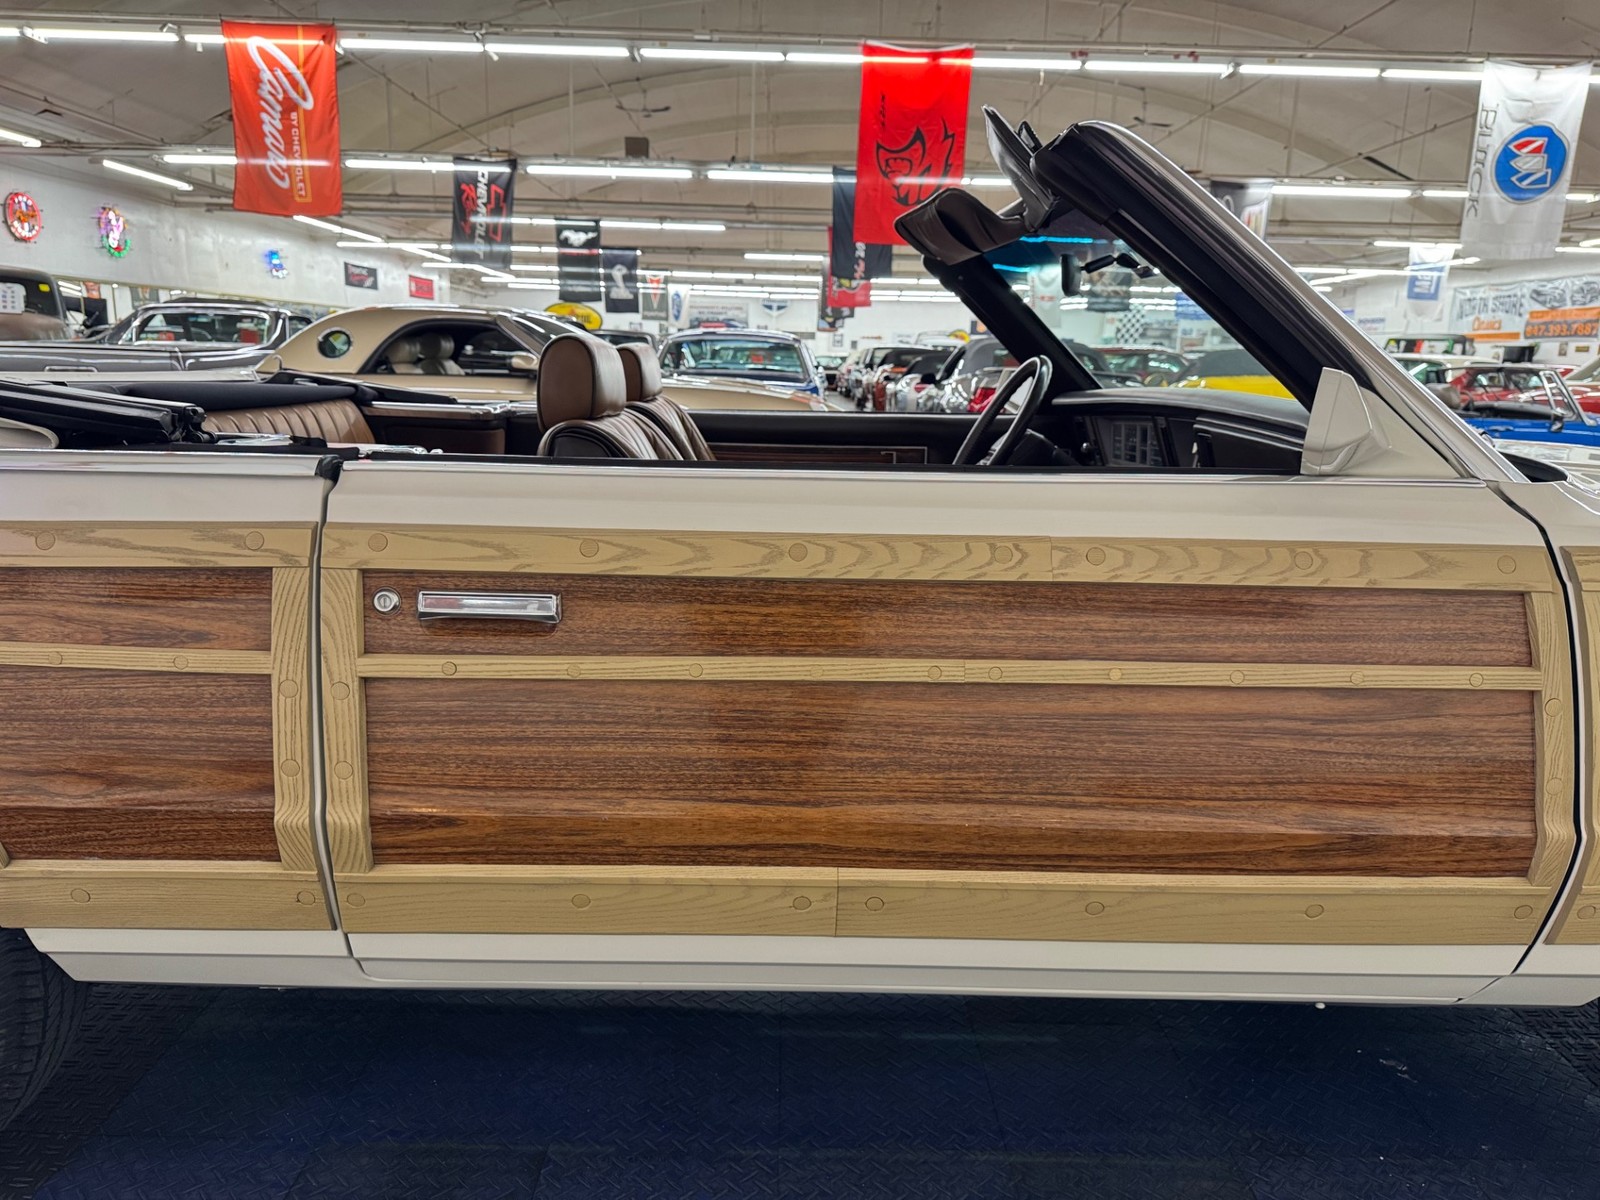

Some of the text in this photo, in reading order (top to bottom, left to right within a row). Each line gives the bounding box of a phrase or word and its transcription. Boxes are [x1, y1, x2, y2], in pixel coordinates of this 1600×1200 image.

[247, 35, 314, 189] Camaro
[290, 111, 306, 198] BY CHEVROLET
[1466, 102, 1499, 219] BUICK
[474, 169, 489, 260] CHEVROLET
